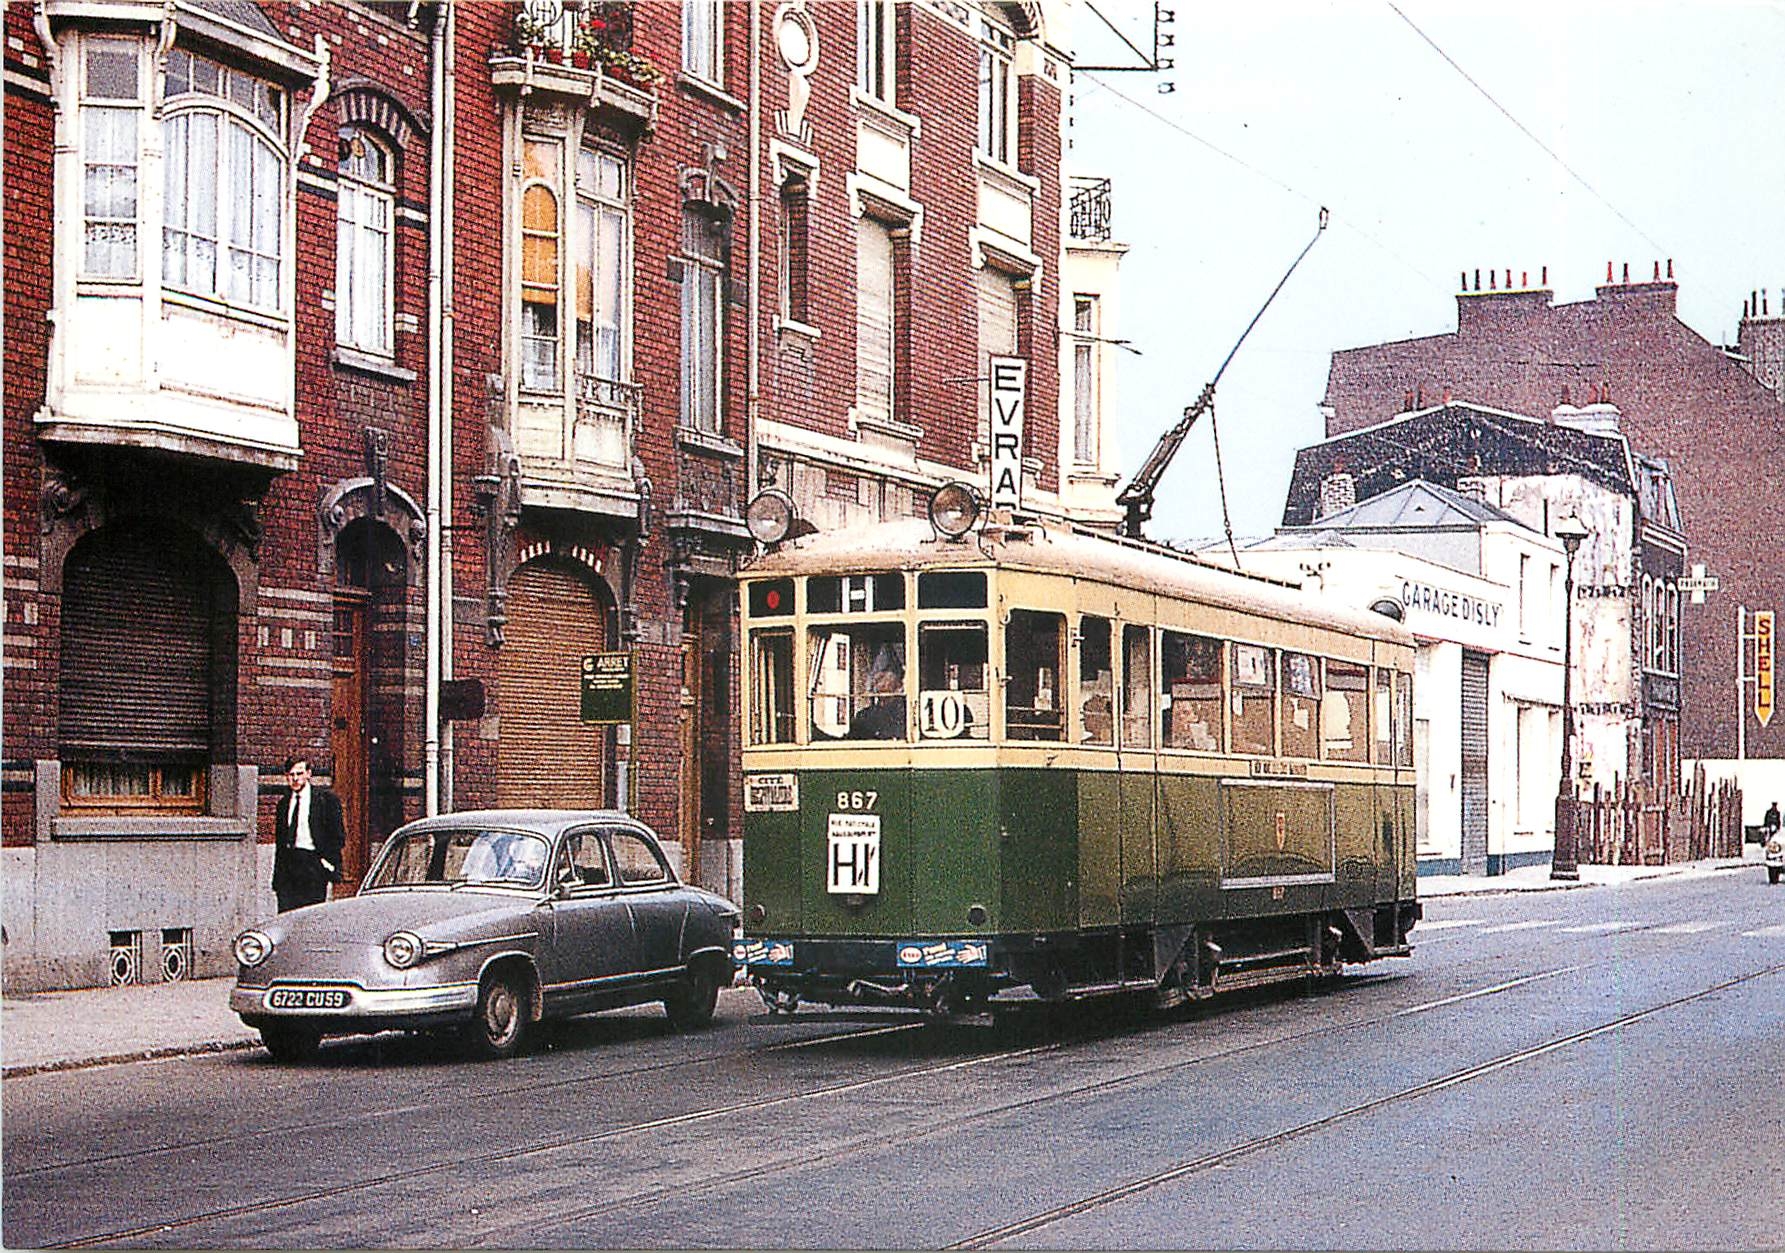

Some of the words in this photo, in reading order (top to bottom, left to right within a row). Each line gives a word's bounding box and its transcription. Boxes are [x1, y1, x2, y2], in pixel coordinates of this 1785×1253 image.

[1402, 581, 1459, 618] GARAGE
[1462, 598, 1501, 628] DISLY
[1758, 618, 1771, 708] SHELL
[923, 696, 962, 733] 10
[837, 791, 878, 810] 867
[273, 991, 303, 1007] 6722
